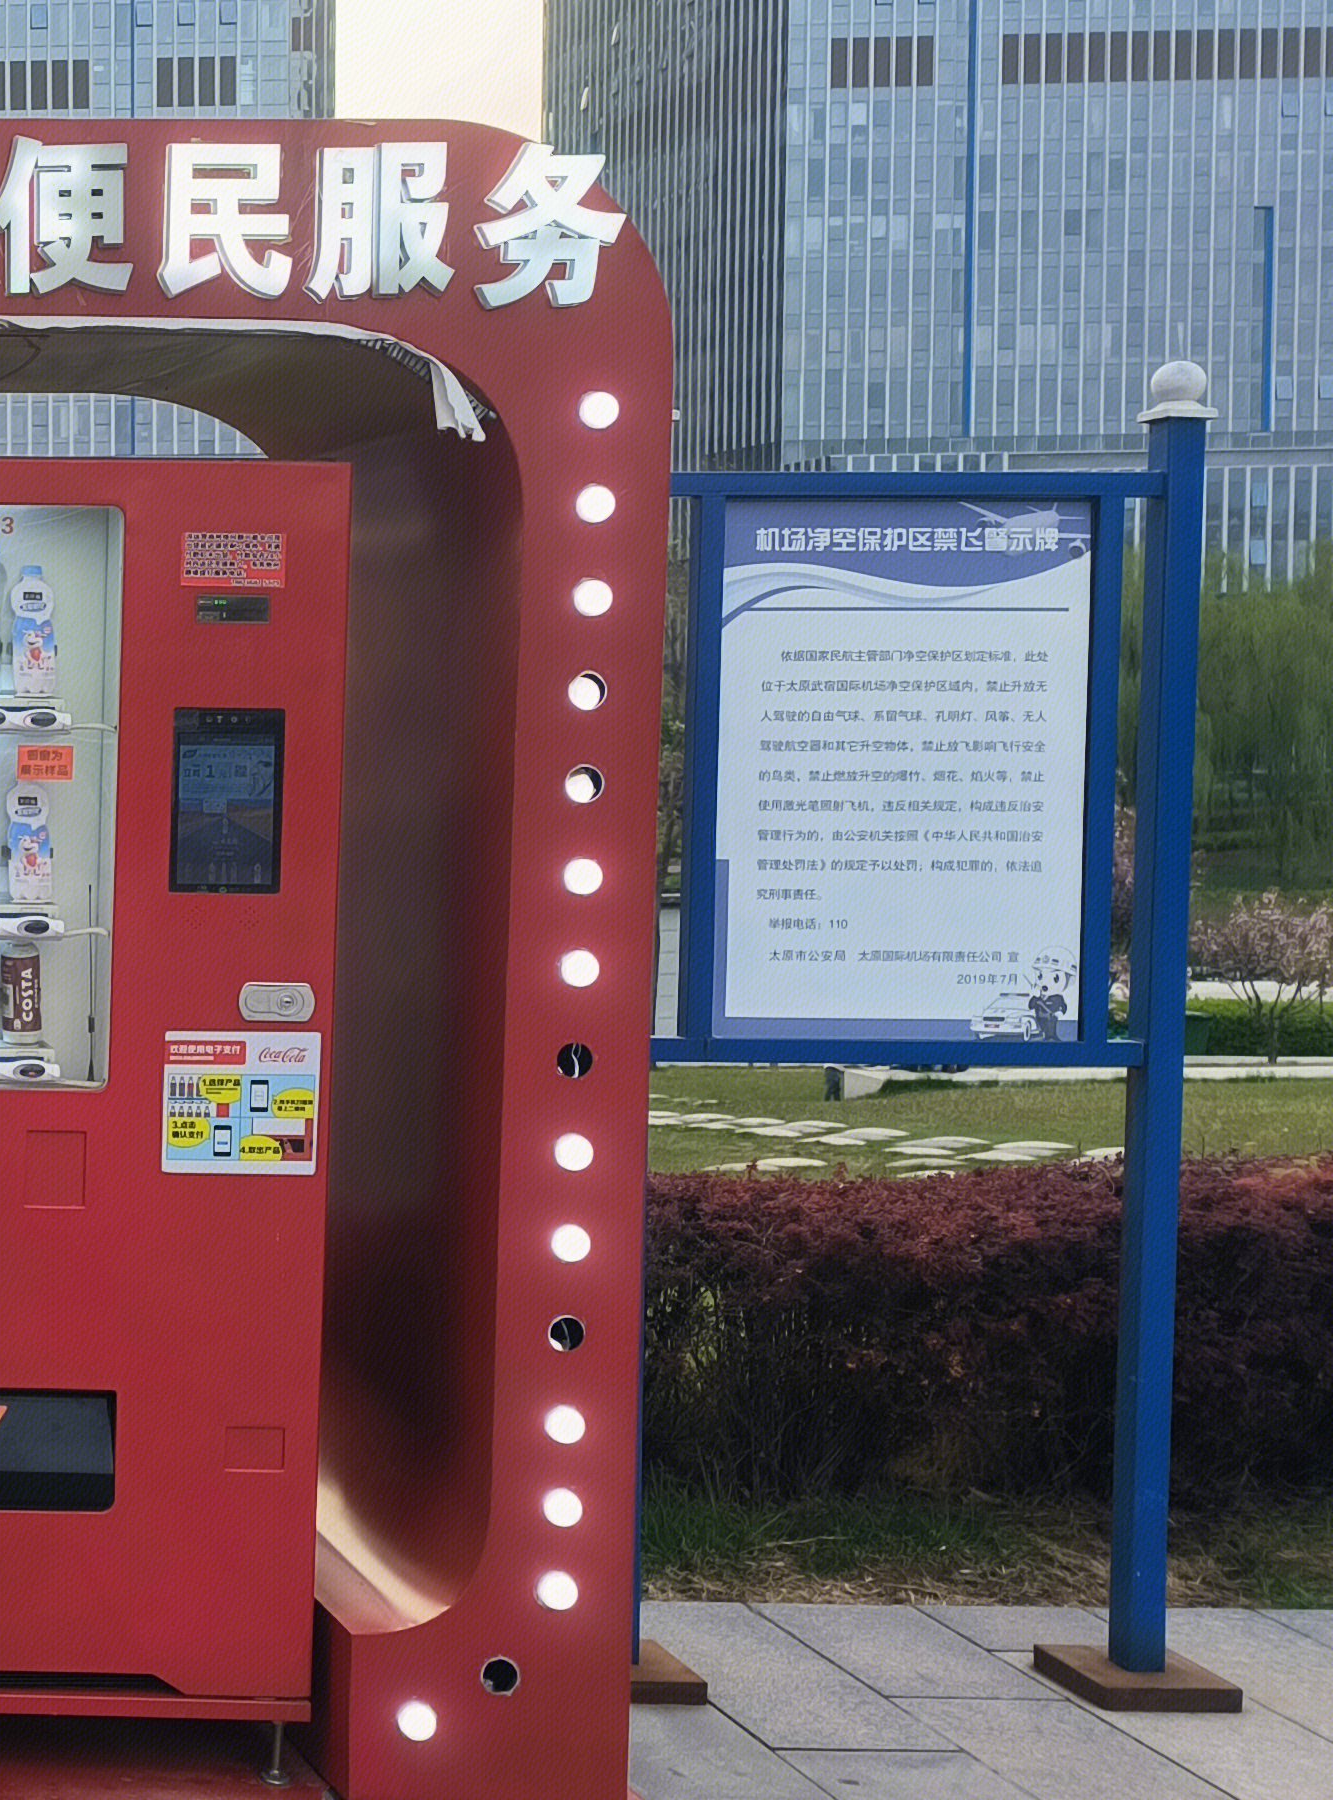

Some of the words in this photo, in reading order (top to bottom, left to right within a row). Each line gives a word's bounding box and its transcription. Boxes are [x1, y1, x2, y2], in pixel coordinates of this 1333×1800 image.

[755, 527, 1059, 552] 机场净空保护区禁飞警示牌
[769, 949, 846, 961] 太原市公安局
[858, 950, 1001, 962] 太原国际机场有限责任公司
[957, 973, 1018, 985] 2019年7月
[21, 968, 33, 1022] COSTA
